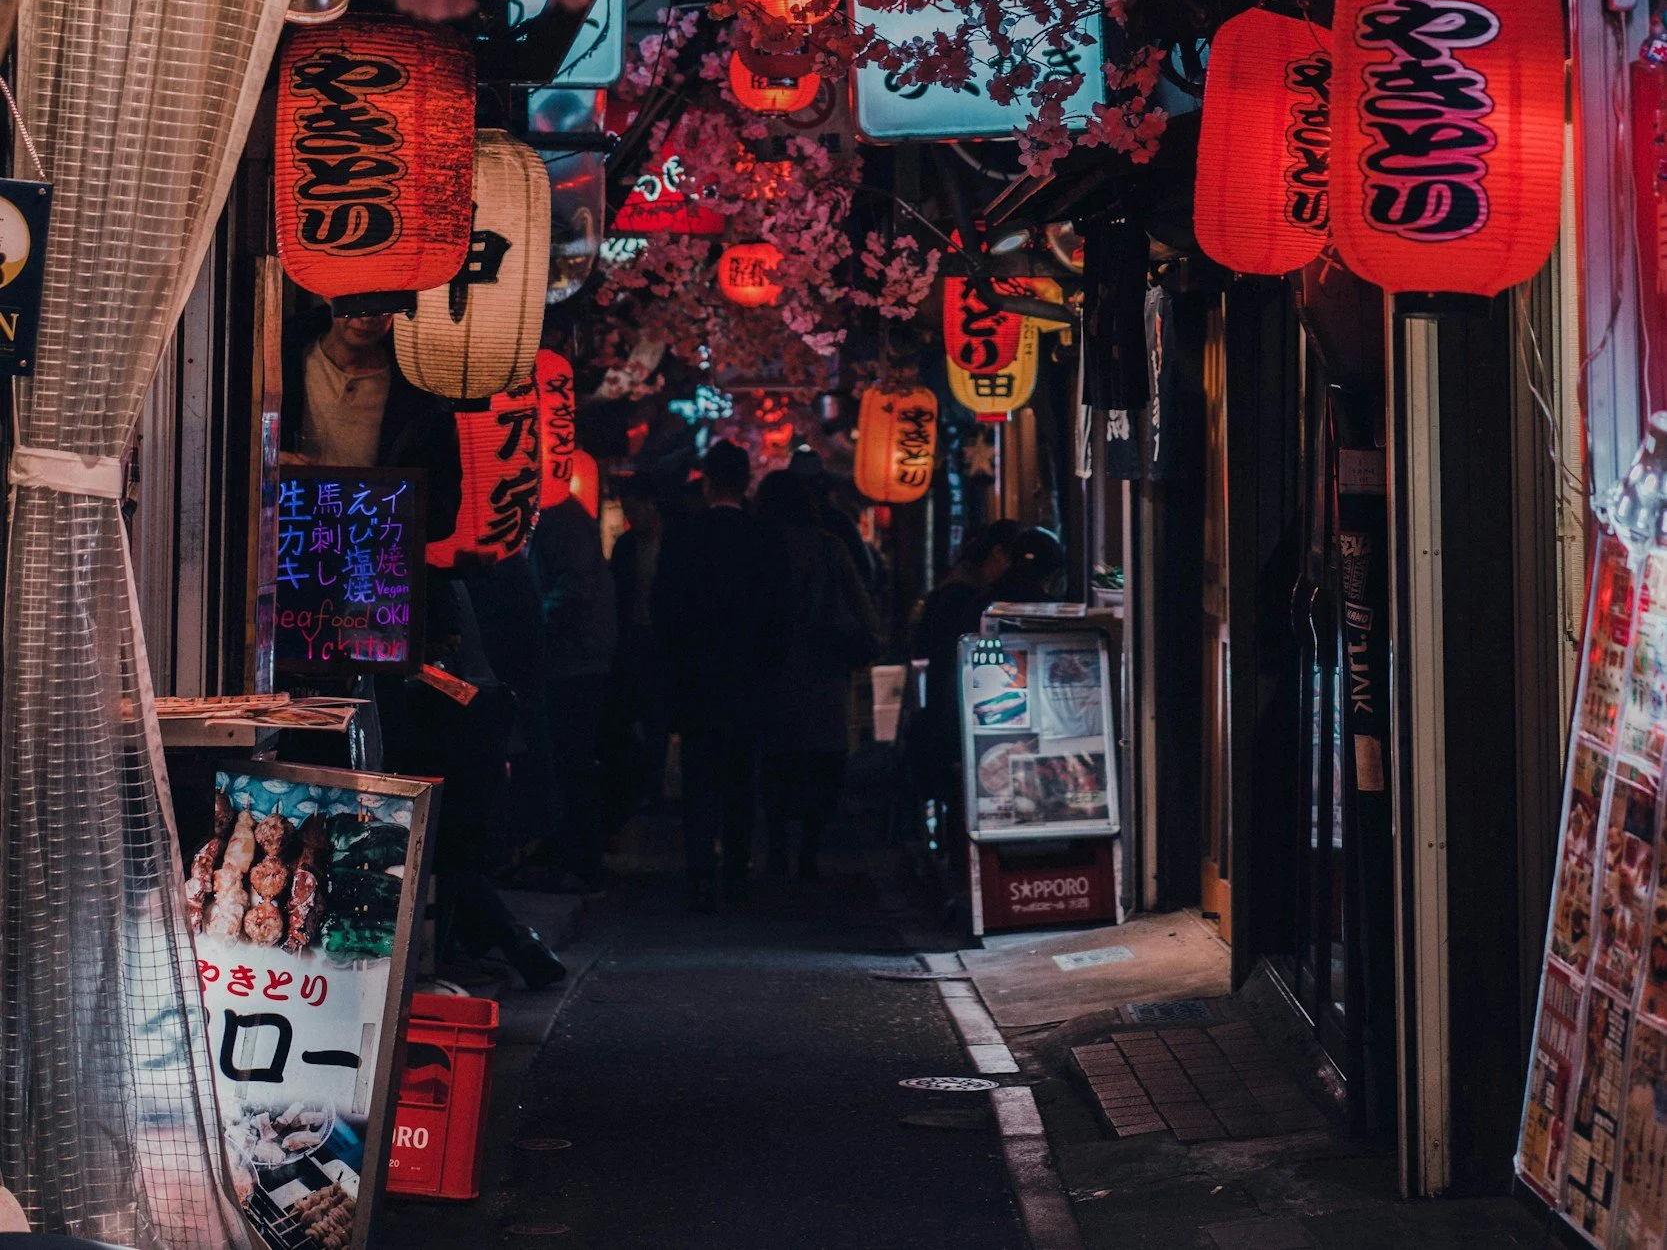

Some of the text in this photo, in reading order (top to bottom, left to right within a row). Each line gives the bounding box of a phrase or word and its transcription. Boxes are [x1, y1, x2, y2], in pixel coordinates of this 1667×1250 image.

[293, 52, 405, 250] やきとり
[278, 480, 312, 590] 生カキ
[309, 483, 343, 586] 馬刺し
[342, 482, 377, 603] えび塩焼
[376, 480, 409, 577] イカ焼
[375, 579, 409, 598] Vegan
[1009, 877, 1090, 901] SAPPORO
[197, 959, 328, 1007] やきとり
[392, 1125, 429, 1150] RO
